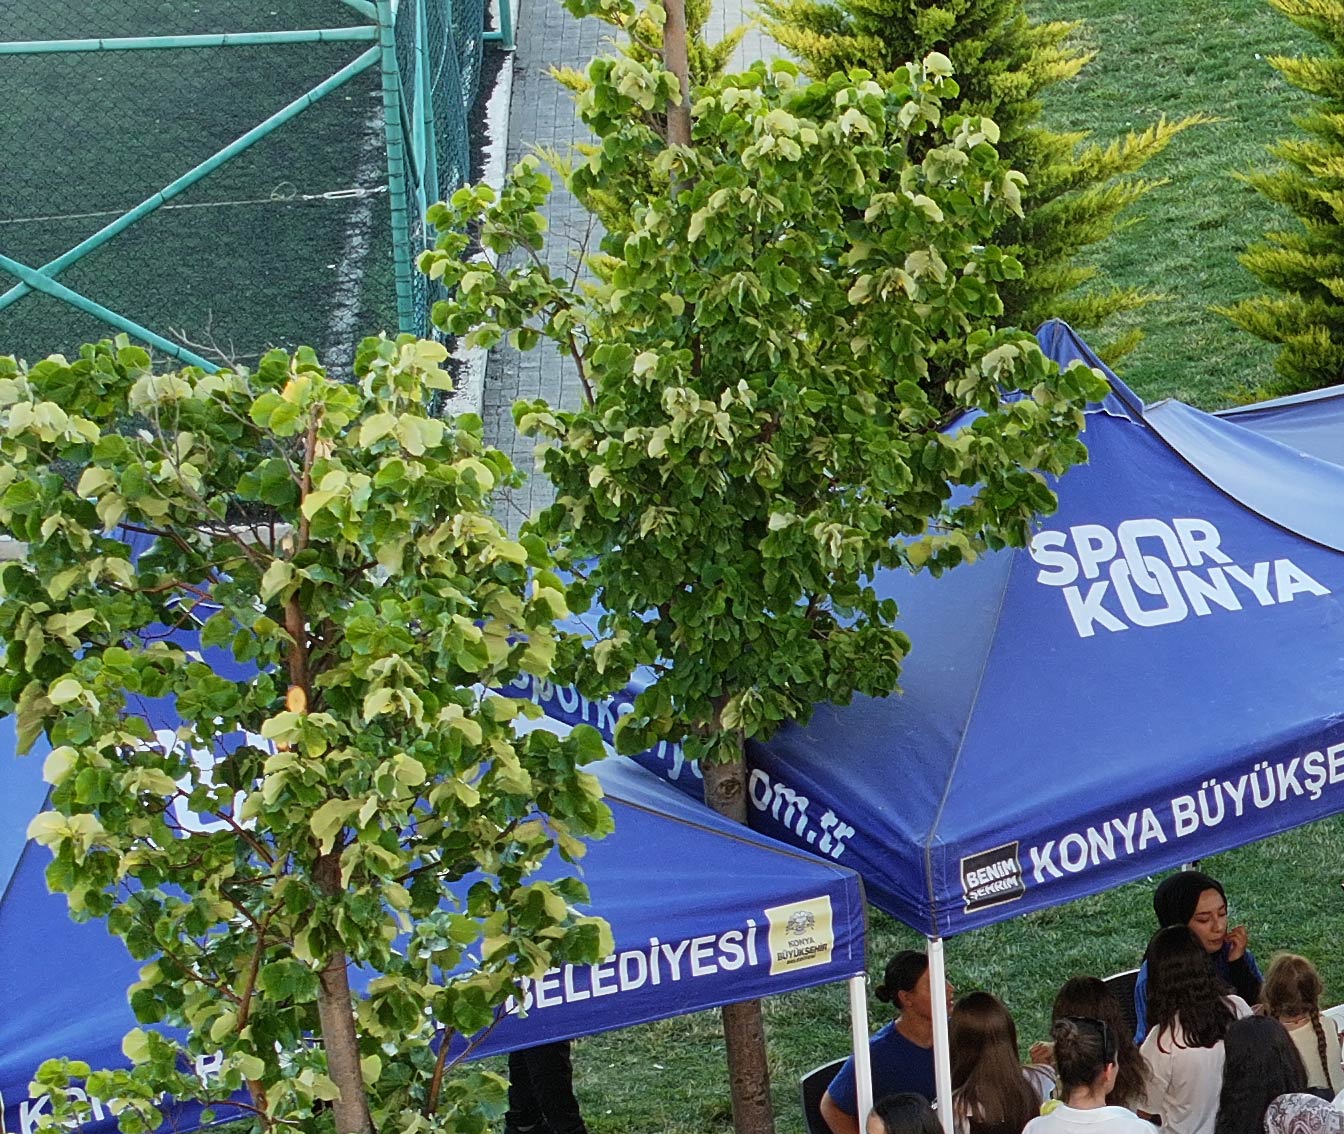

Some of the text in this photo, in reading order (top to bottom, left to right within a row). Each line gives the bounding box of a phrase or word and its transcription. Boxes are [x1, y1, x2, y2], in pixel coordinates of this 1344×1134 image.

[1029, 518, 1233, 594] SPOR
[1062, 556, 1332, 638] KONYA
[966, 858, 1017, 888] BENİM
[1030, 807, 1167, 884] KONYA
